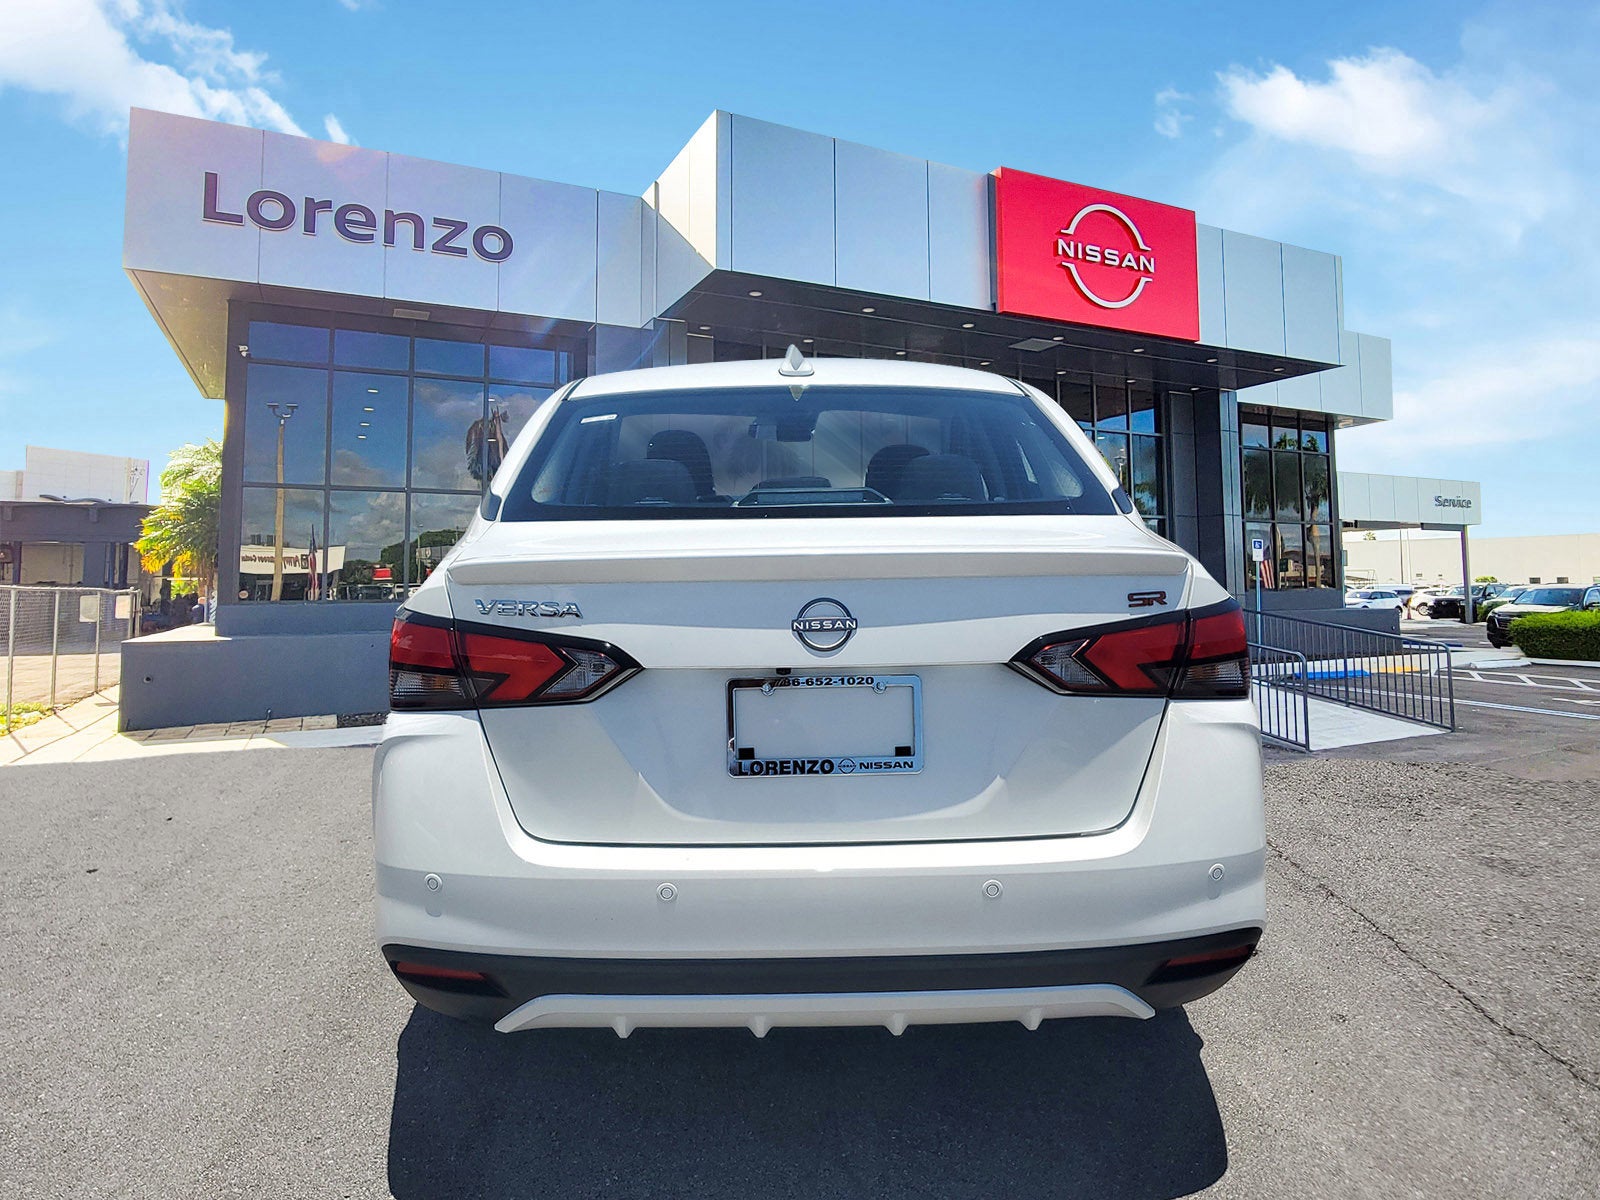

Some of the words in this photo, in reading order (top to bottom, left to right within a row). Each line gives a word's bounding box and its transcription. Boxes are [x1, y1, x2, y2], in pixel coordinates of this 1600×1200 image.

[203, 171, 514, 262] Lorenzo
[1057, 238, 1155, 273] NISSAN
[1434, 495, 1472, 509] Service
[1127, 590, 1168, 608] SR
[475, 598, 584, 619] VERSA
[793, 620, 857, 630] NISSAN
[737, 759, 835, 776] LORENZO
[859, 760, 914, 770] NISSAN
